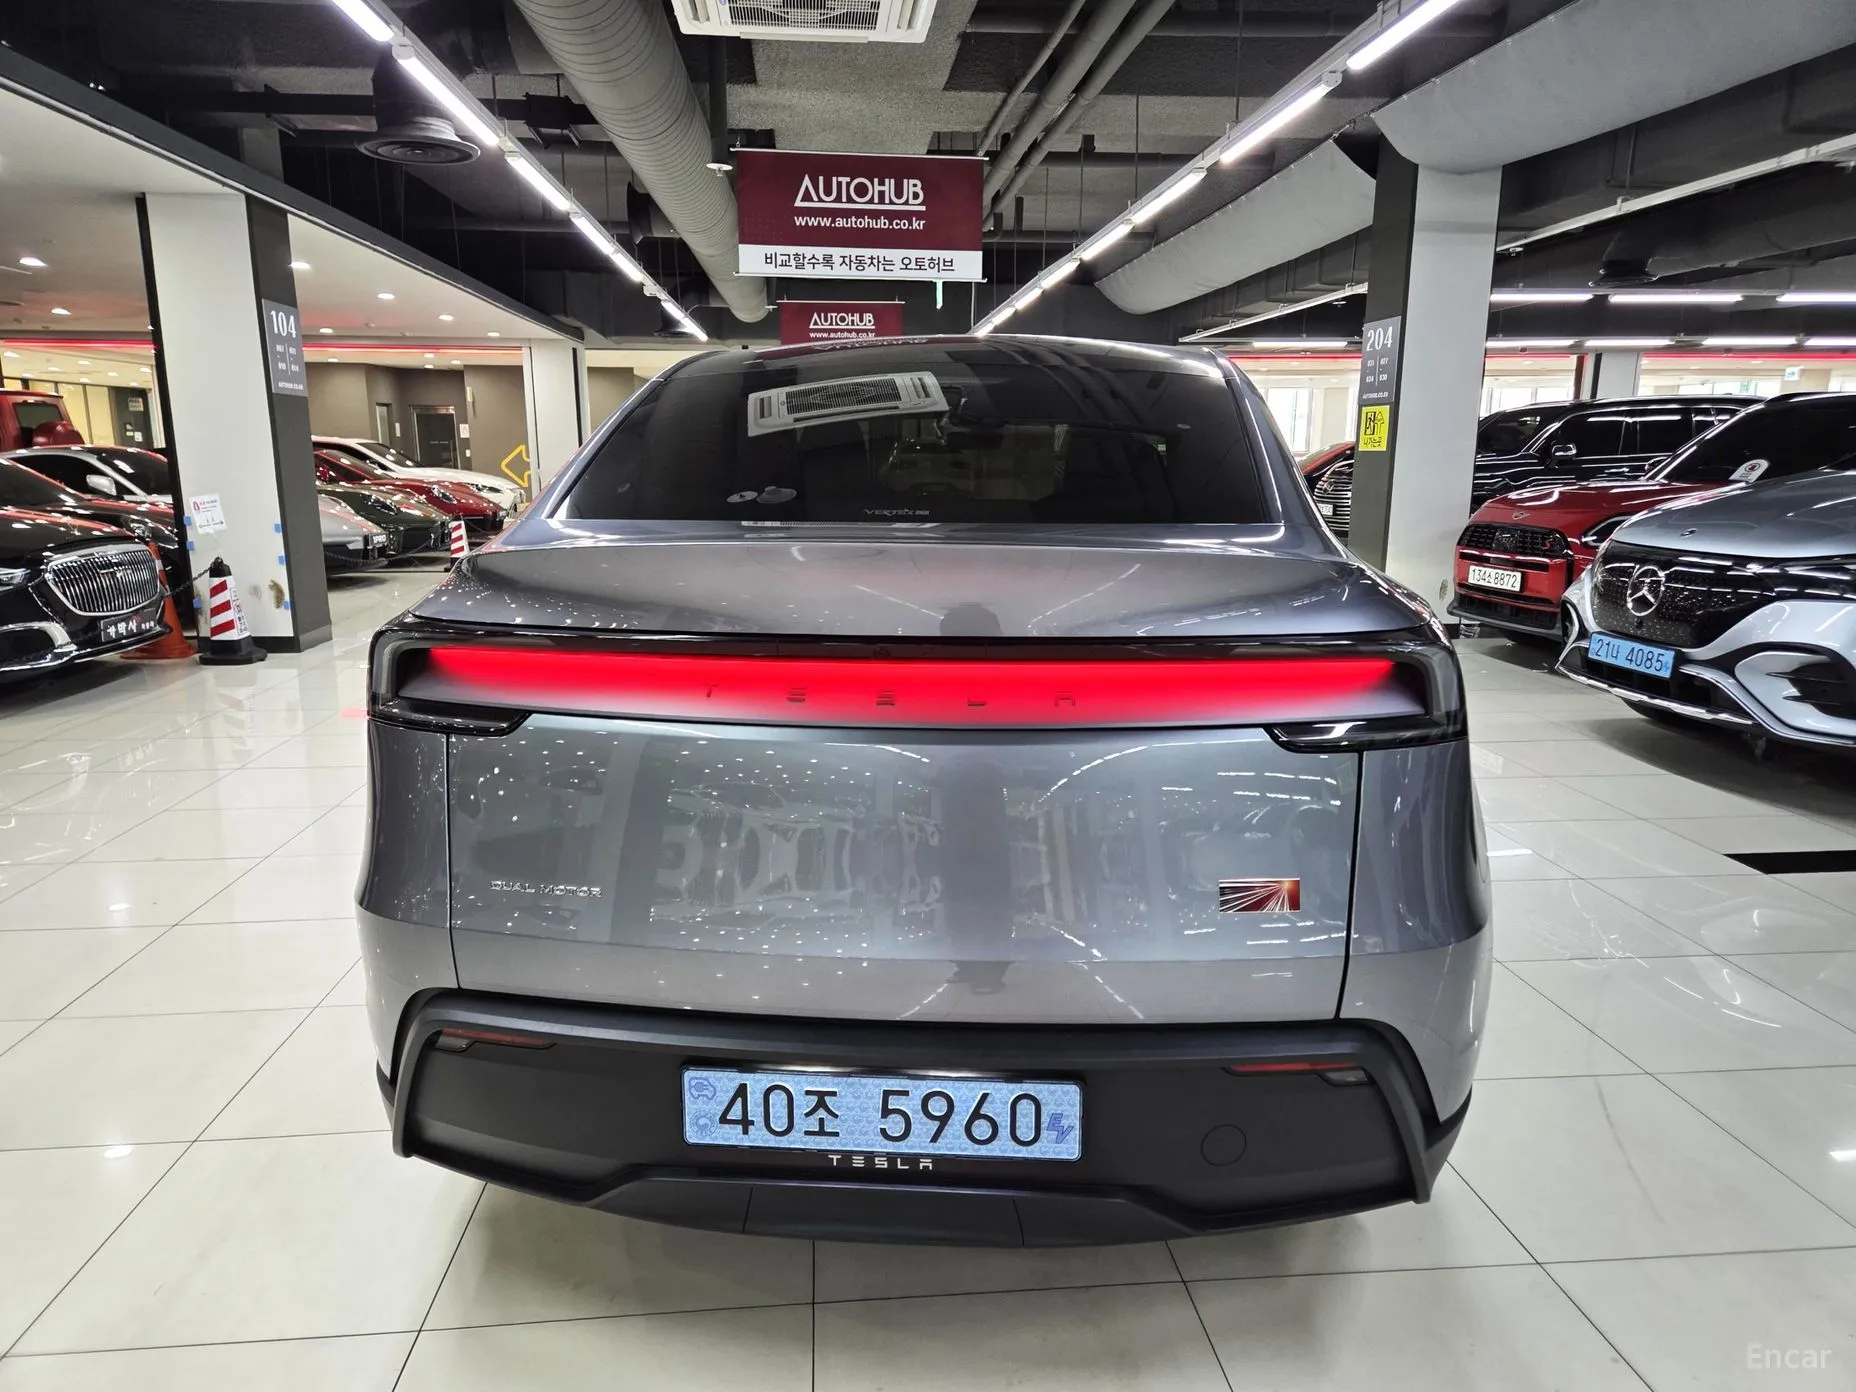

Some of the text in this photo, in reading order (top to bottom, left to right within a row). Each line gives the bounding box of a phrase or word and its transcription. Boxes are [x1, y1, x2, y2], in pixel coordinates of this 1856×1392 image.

[794, 174, 925, 210] AUTOHUB
[794, 215, 926, 230] www.autohub.co.kr
[764, 252, 955, 272] 비교할수록 자동차는 오토허브
[270, 310, 297, 338] 104
[809, 312, 875, 329] AUTOHUB
[1366, 326, 1393, 351] 204
[1595, 639, 1665, 672] 21나 4085
[489, 881, 602, 898] DUAL MOTOR
[718, 1082, 841, 1138] 40조
[879, 1089, 1042, 1147] 5960
[829, 1155, 933, 1170] TESLA
